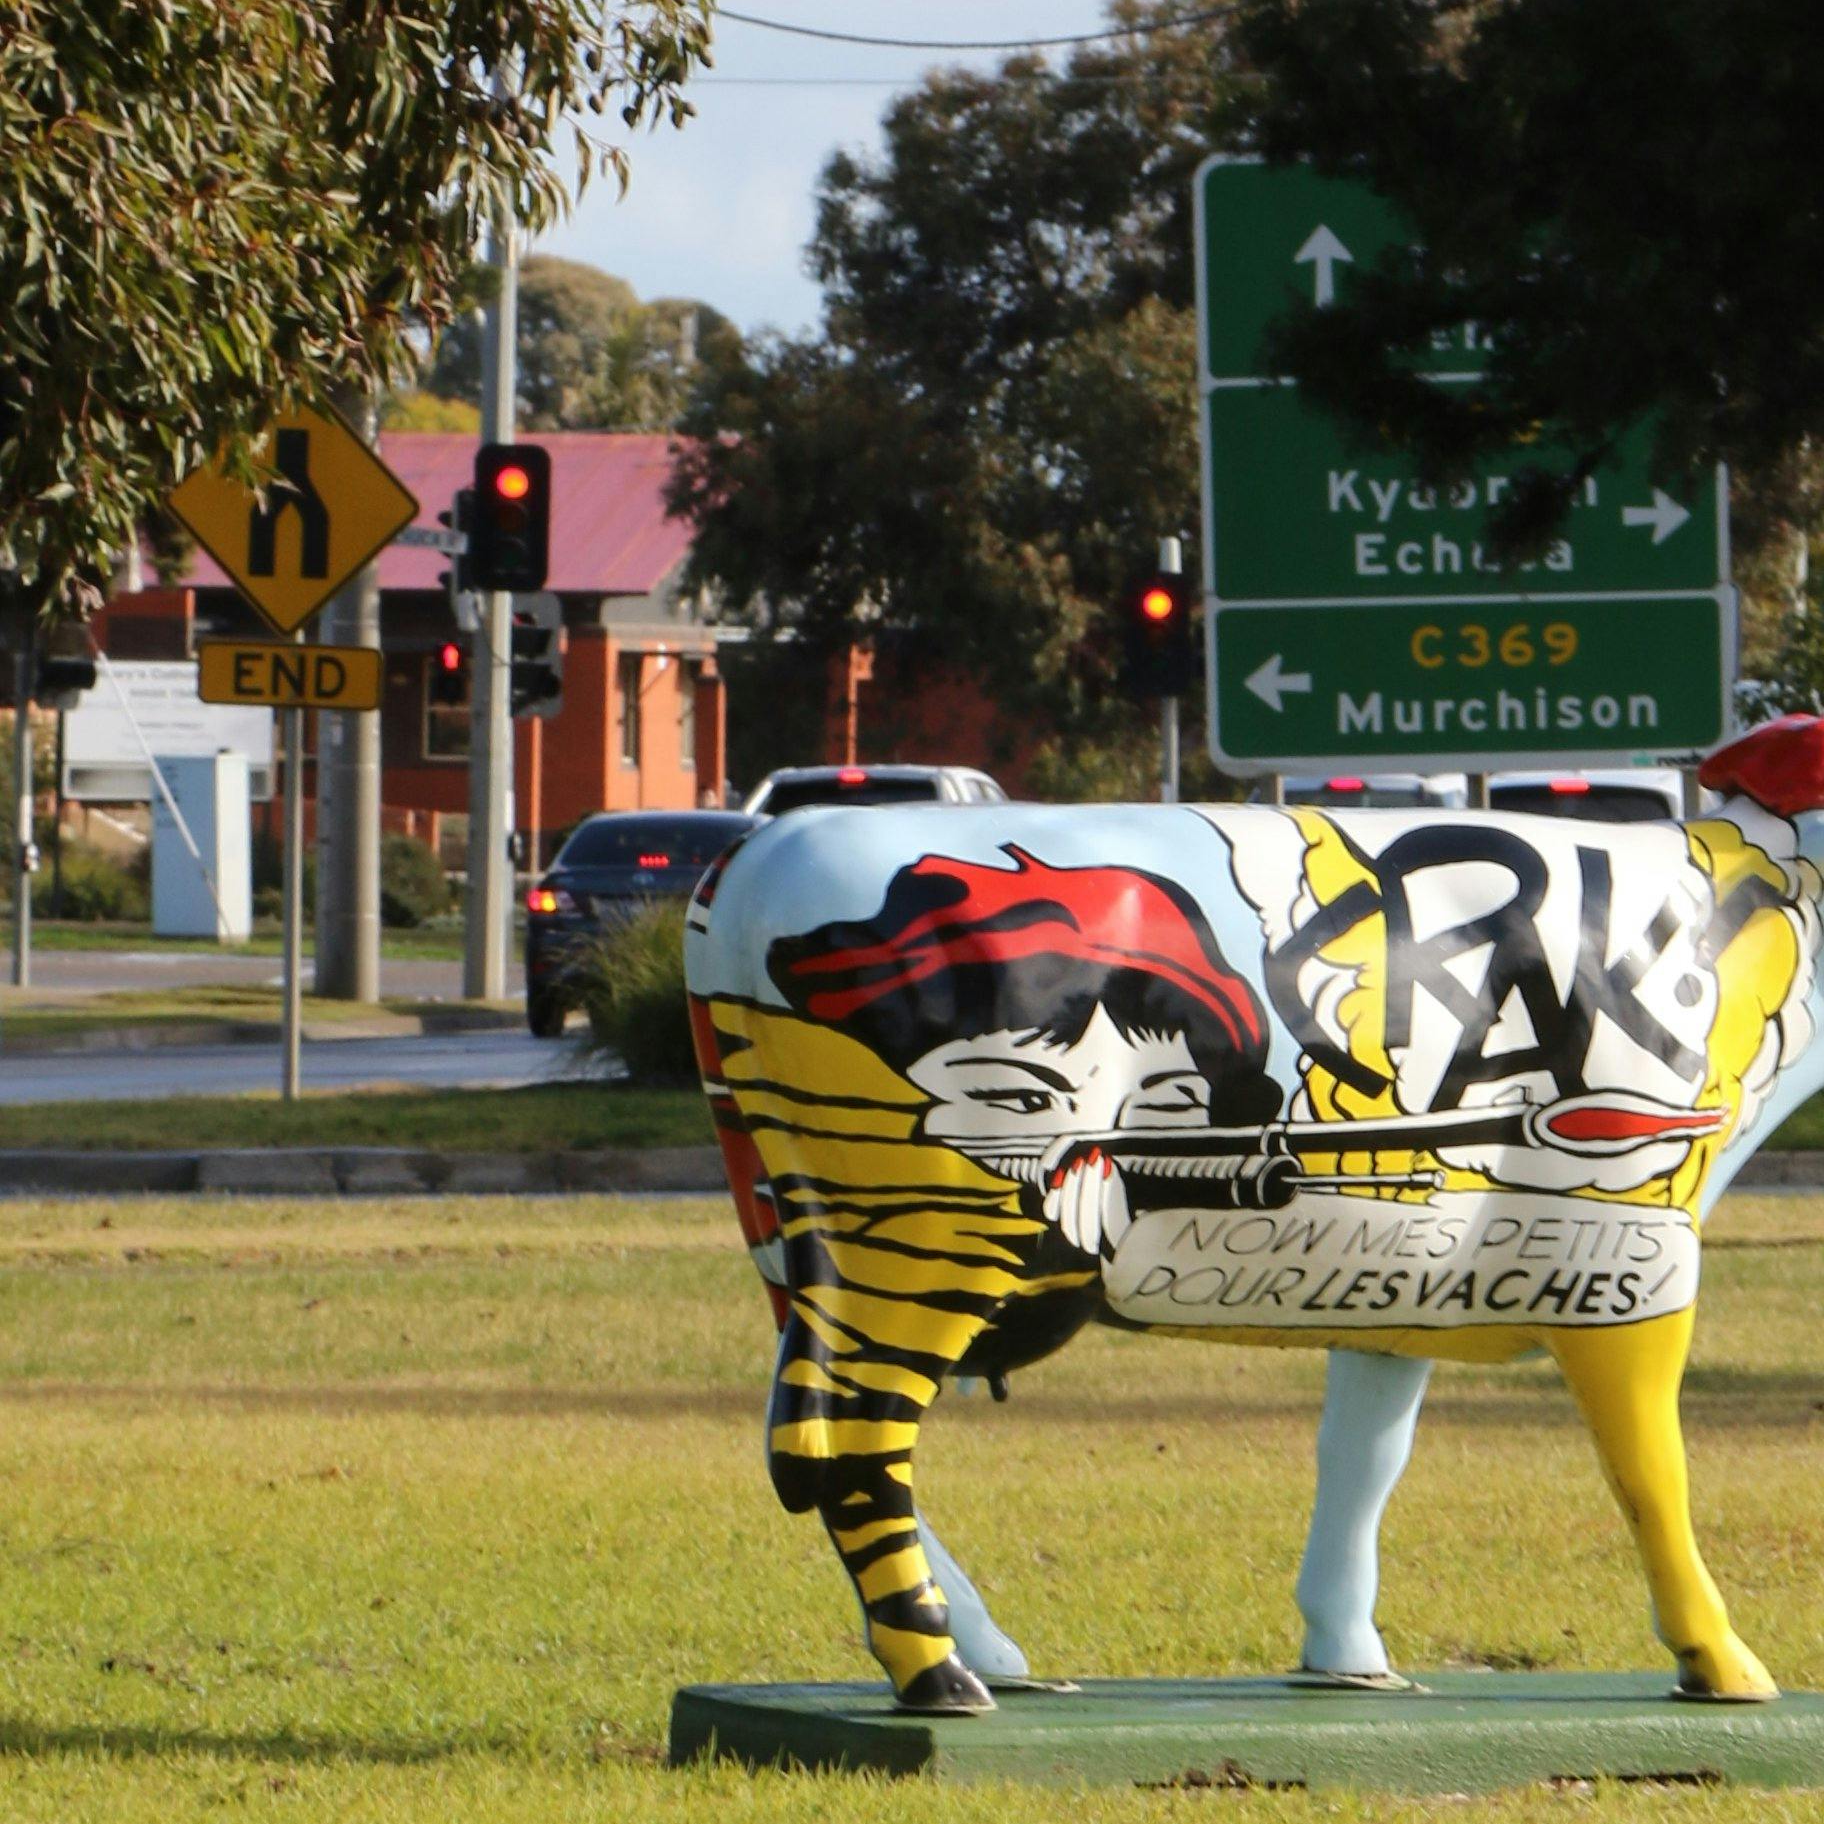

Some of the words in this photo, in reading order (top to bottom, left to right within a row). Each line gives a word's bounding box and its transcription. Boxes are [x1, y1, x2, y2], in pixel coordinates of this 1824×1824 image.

[1354, 532, 1574, 575] Echua
[1410, 621, 1580, 668] C369
[233, 652, 347, 699] END
[1336, 687, 1659, 735] Murchison
[1341, 1217, 1468, 1259] MES
[1471, 1217, 1667, 1263] PETITS
[1122, 1265, 1306, 1307] POUR
